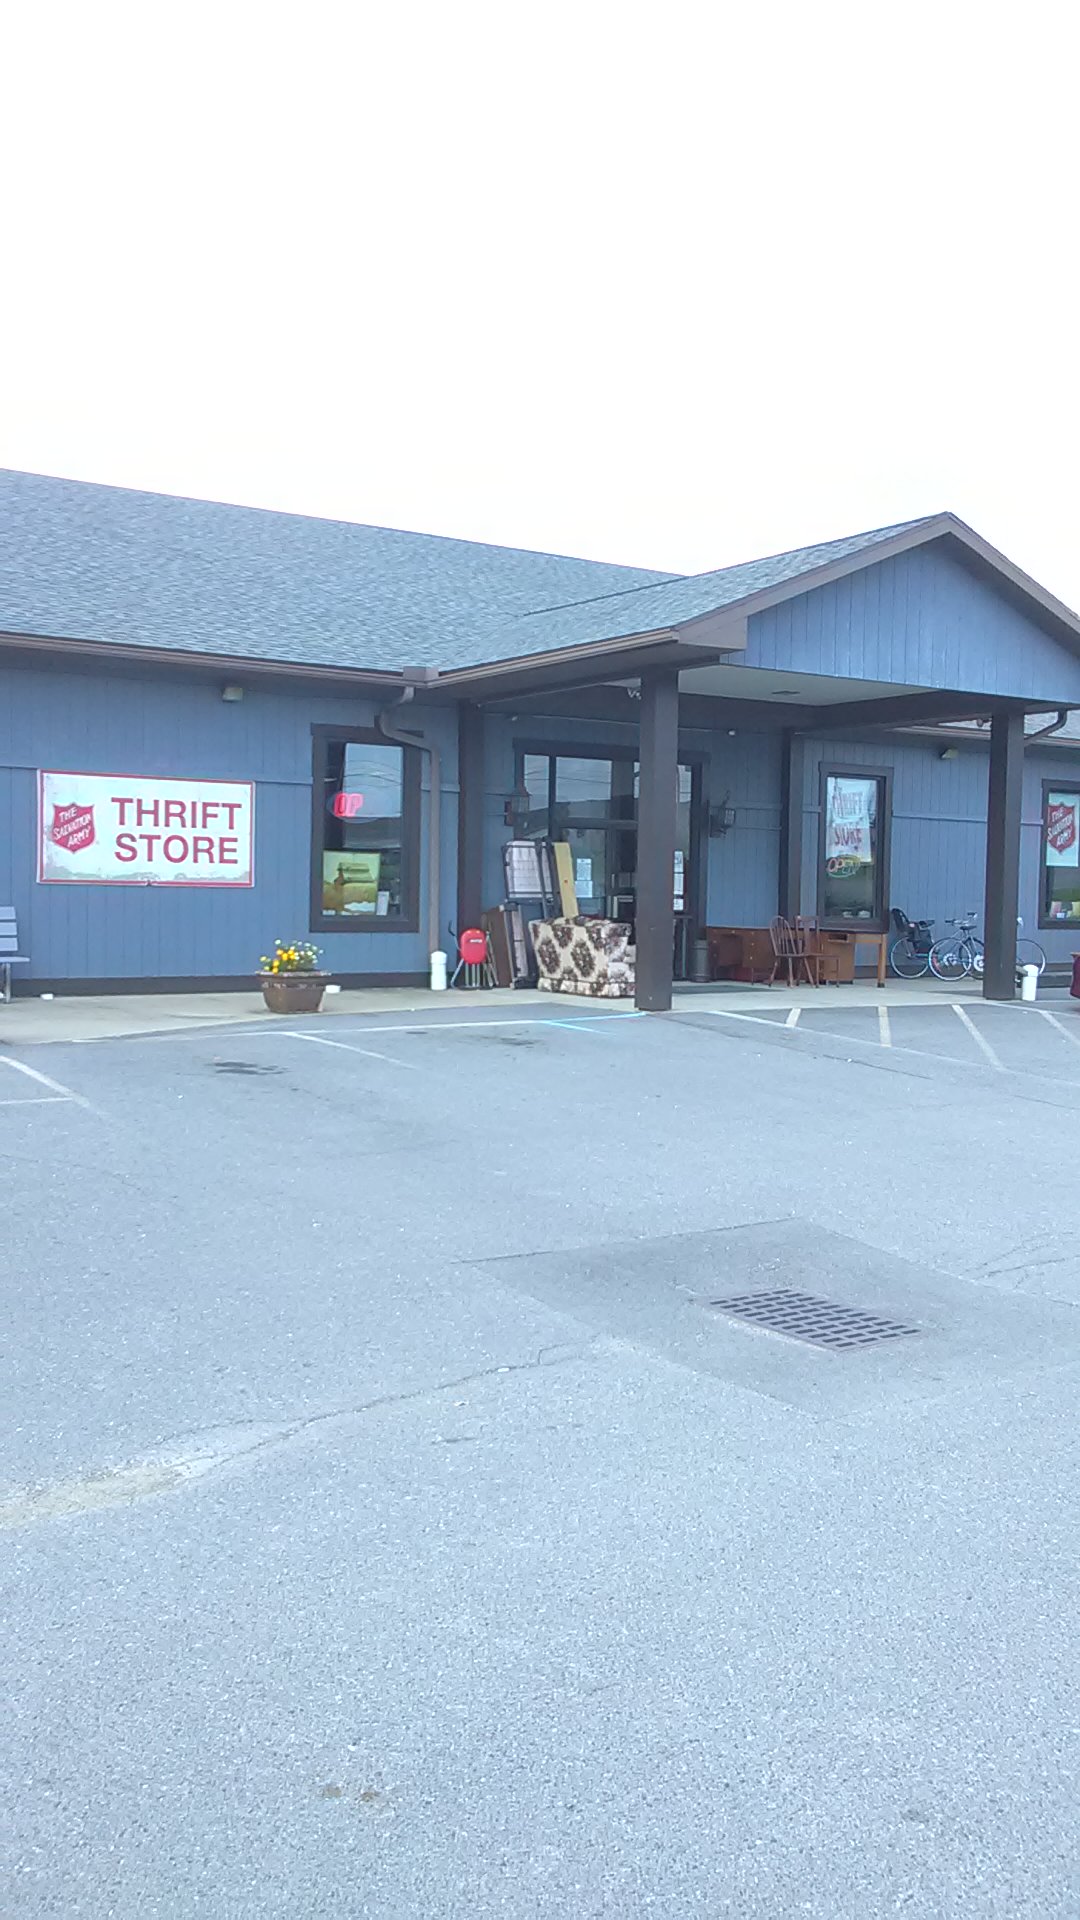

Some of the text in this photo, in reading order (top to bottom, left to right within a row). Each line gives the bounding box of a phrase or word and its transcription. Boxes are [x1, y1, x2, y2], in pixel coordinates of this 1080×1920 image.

[58, 807, 78, 822] THE
[111, 797, 242, 830] THRIFT
[1051, 807, 1066, 823] THE
[53, 813, 91, 841] SALVATION
[67, 825, 91, 848] ARMY
[1056, 825, 1073, 848] ARMY
[114, 833, 239, 864] STORE
